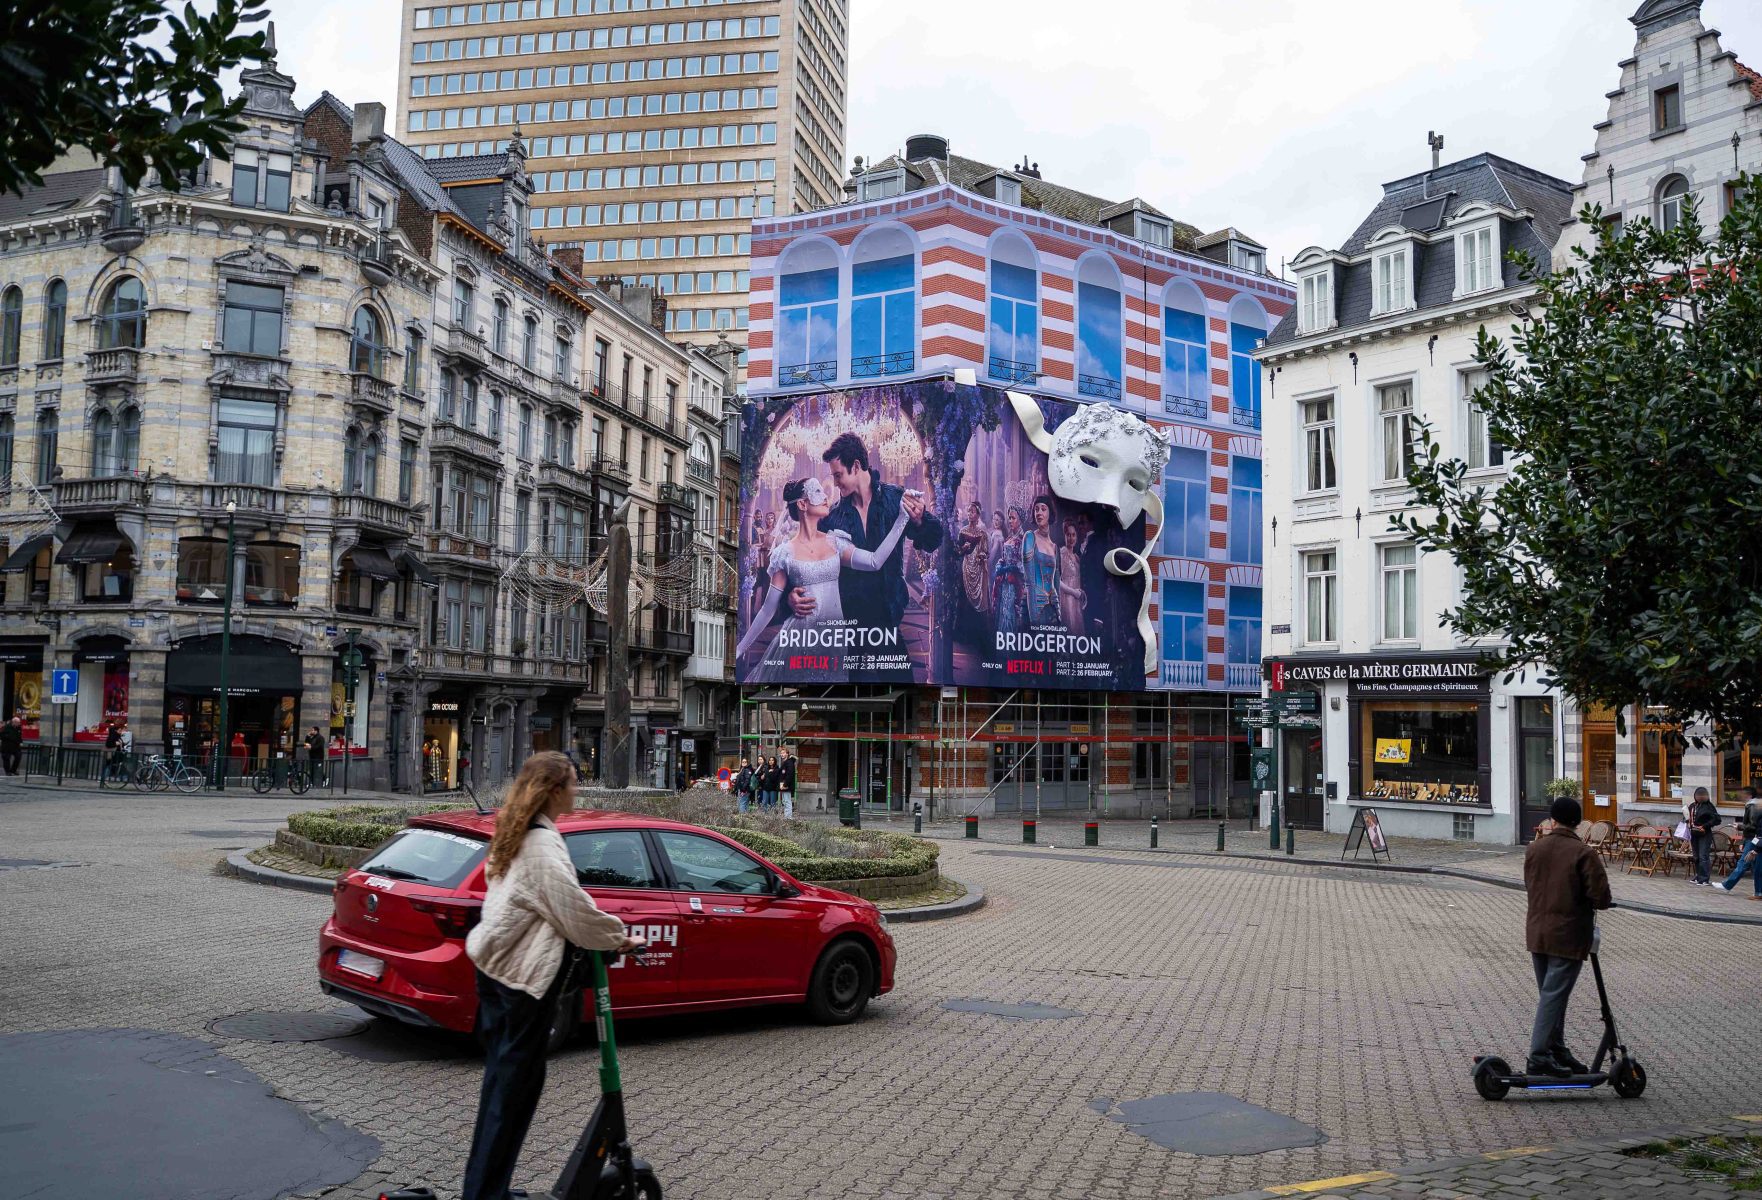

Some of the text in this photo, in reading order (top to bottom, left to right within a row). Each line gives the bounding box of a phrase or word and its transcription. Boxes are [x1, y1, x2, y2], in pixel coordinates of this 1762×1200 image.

[780, 626, 898, 648] BRIDGERTON
[996, 632, 1100, 654] BRIDGERTON
[789, 655, 829, 670] NETFLIX
[1007, 659, 1044, 675] NETFLIX
[1293, 666, 1330, 679] CAVES
[1333, 665, 1346, 678] de
[1349, 665, 1360, 678] la
[1362, 662, 1400, 678] MÈRE
[1402, 663, 1478, 677] GERMAINE
[1389, 683, 1432, 691] Champagnes
[1441, 682, 1478, 691] Spiritueux
[598, 986, 612, 1012] Bolt
